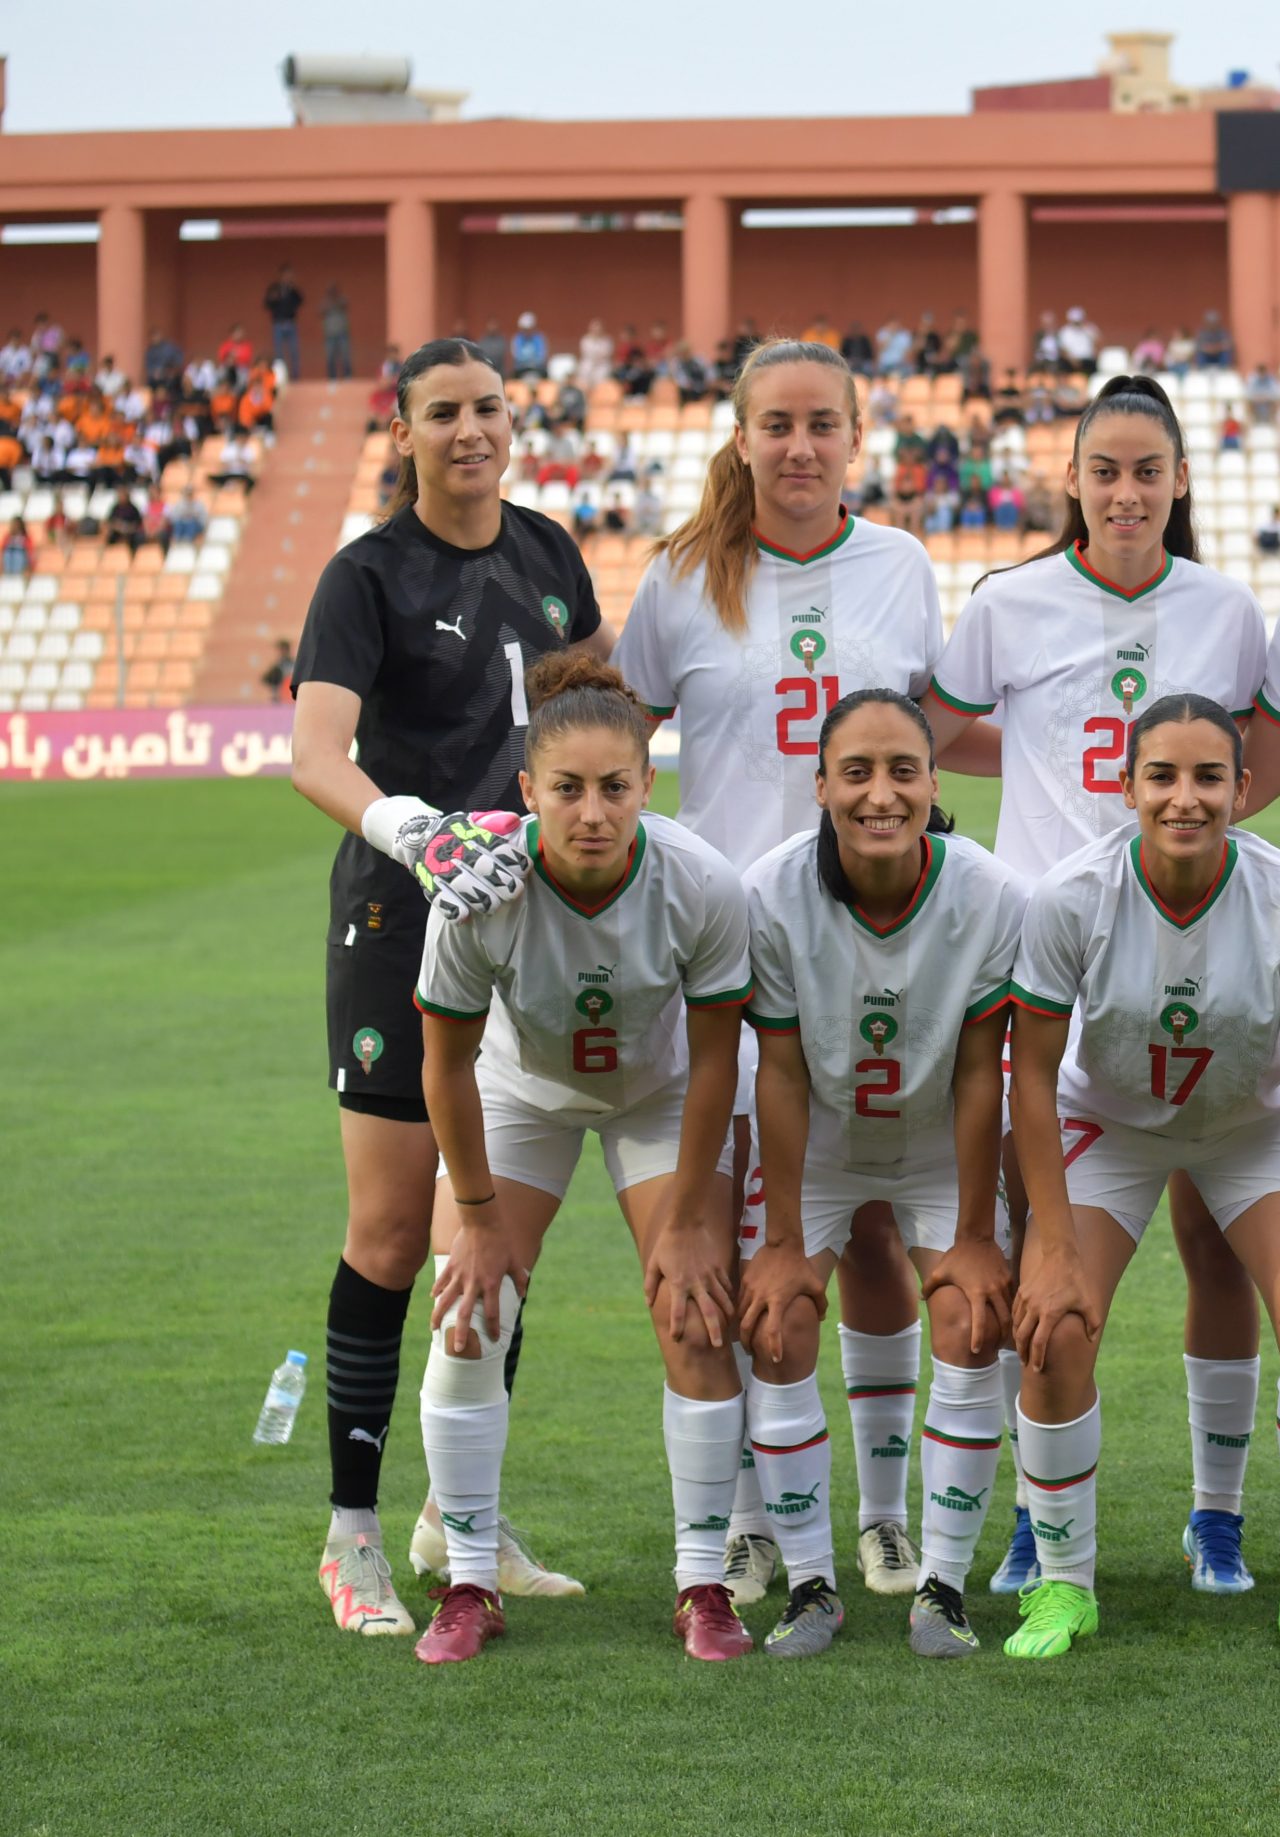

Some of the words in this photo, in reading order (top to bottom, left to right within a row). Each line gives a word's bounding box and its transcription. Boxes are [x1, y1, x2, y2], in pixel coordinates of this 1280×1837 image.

[792, 614, 821, 623] PUMA
[1116, 649, 1145, 662] PUMA
[1083, 717, 1137, 793] 2
[578, 972, 609, 983] PUMA
[1165, 985, 1195, 996] PUMA
[863, 995, 895, 1007] PUMA
[573, 1027, 618, 1074] 6
[1148, 1043, 1215, 1106] 17
[855, 1058, 901, 1118] 2
[1208, 1432, 1246, 1449] PUMA
[765, 1502, 811, 1514] PUMA
[931, 1491, 974, 1512] PUMA
